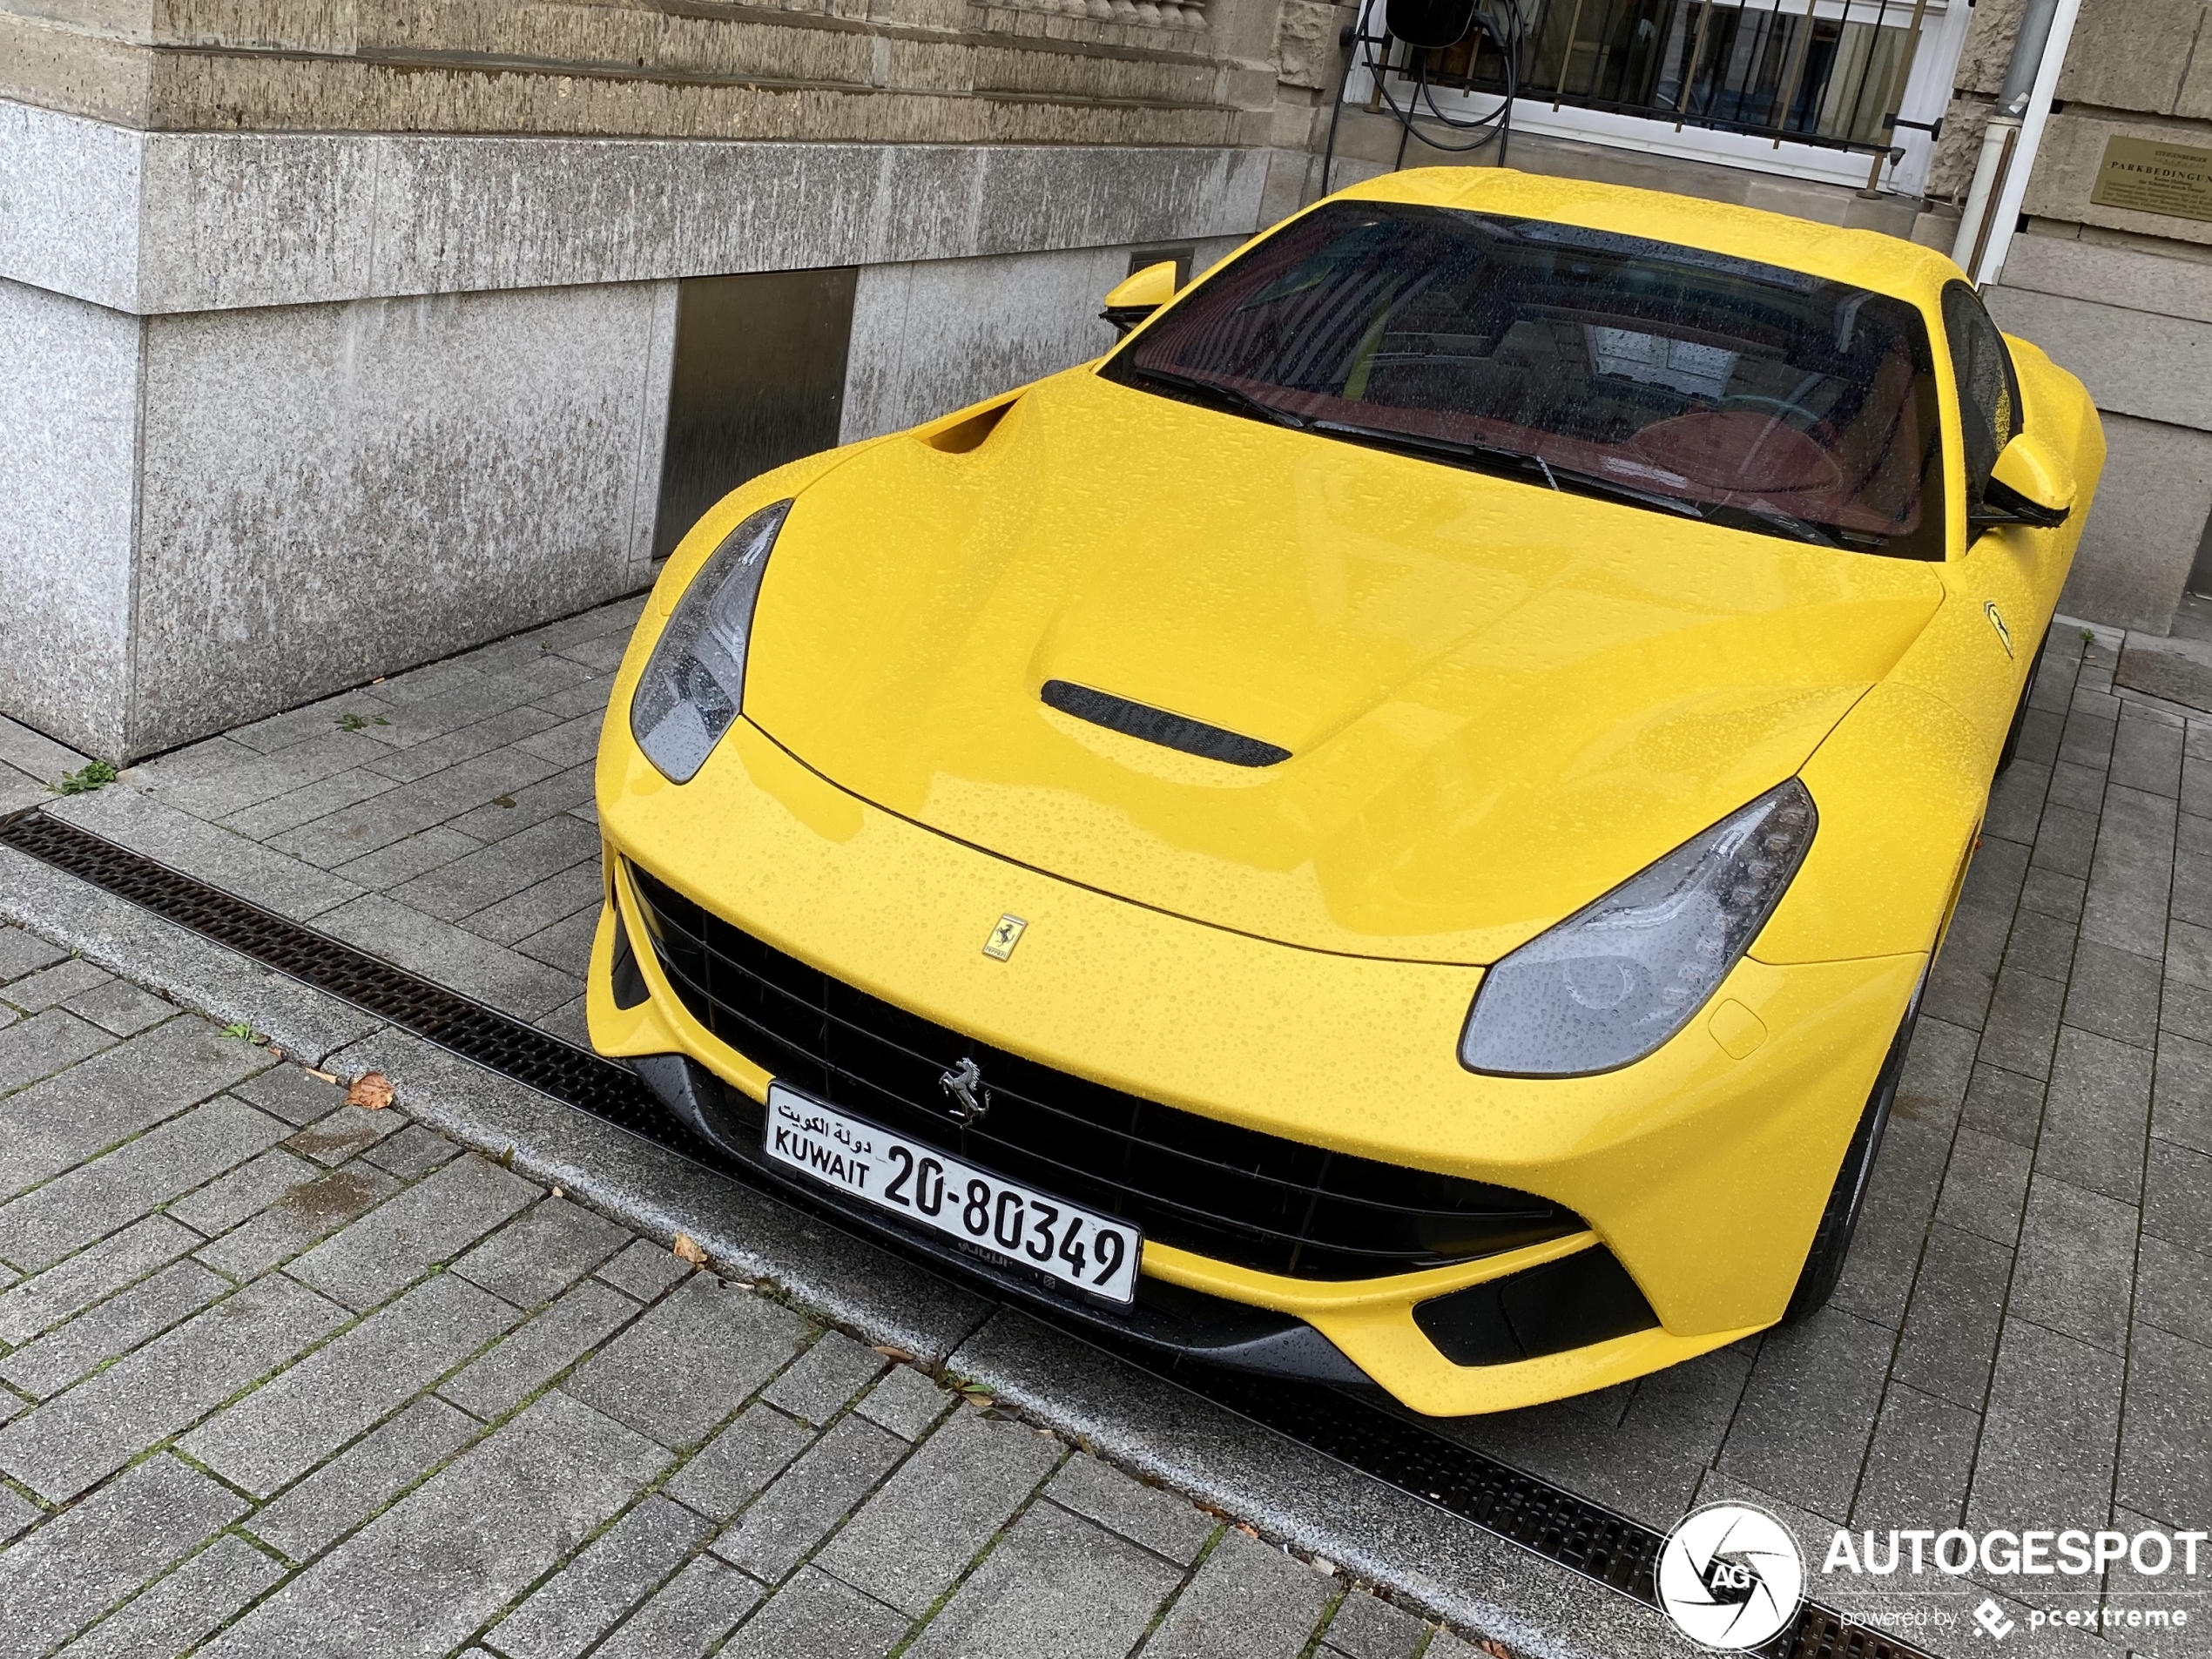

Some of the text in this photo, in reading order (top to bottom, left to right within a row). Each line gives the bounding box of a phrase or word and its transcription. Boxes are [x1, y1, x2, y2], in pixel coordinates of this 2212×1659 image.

[986, 946, 1007, 957] Ferrari
[776, 1125, 870, 1189] KUWAIT
[778, 1105, 871, 1154] دولة الكويت
[884, 1144, 1125, 1286] 20-80349
